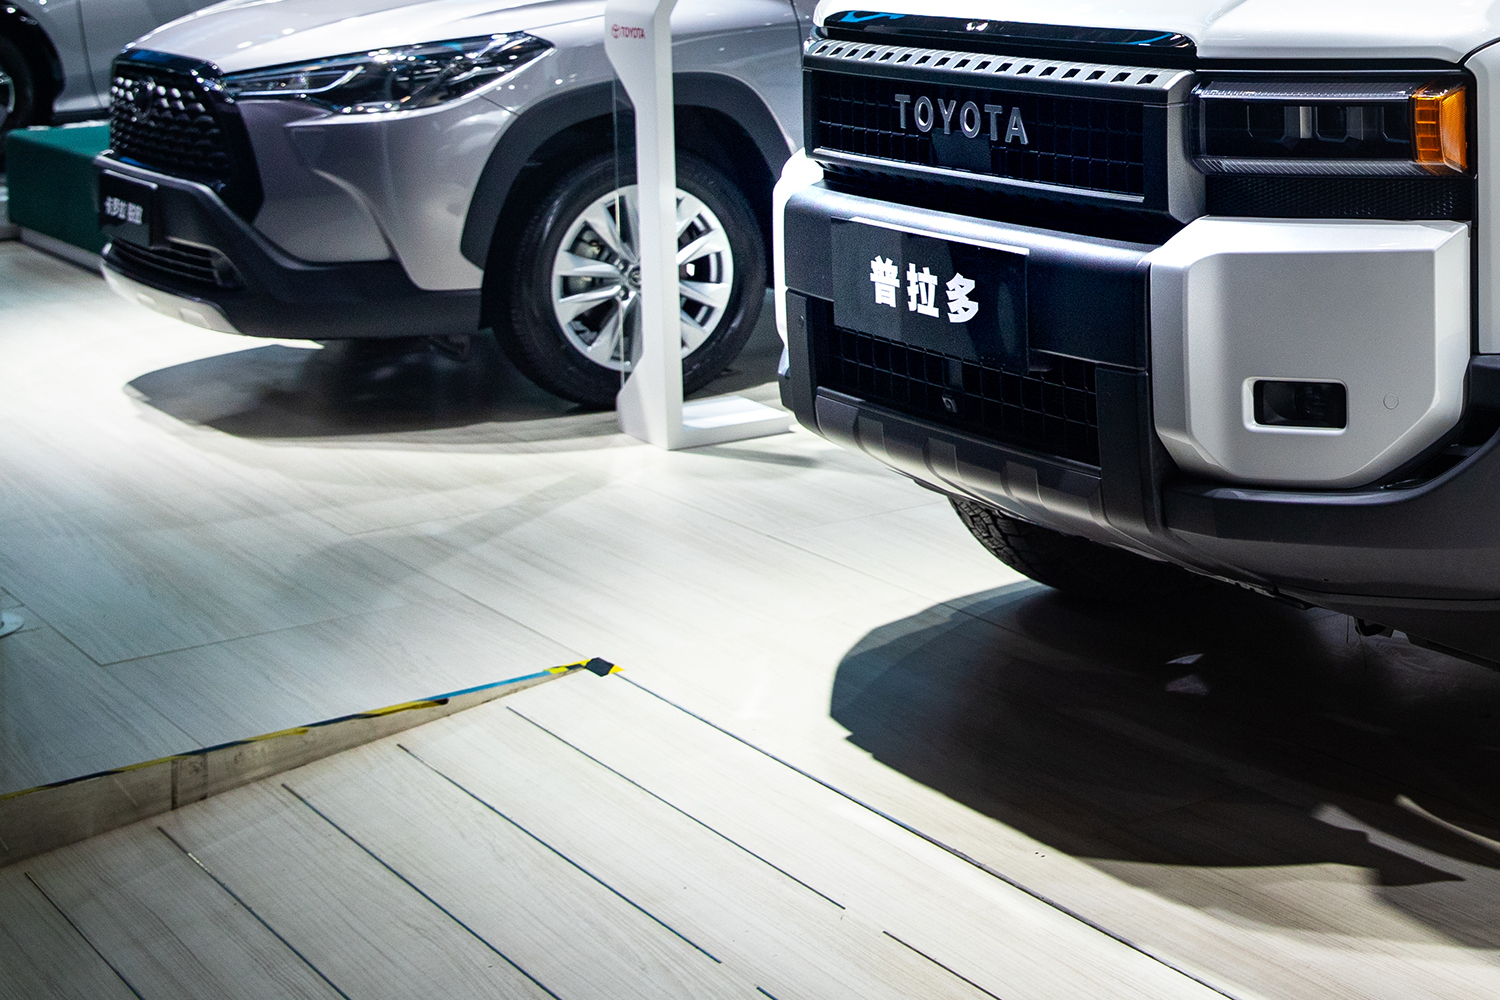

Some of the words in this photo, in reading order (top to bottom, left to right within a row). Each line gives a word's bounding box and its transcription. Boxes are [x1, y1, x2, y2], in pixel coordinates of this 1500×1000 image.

[620, 26, 646, 40] TOYOTA
[894, 93, 1029, 146] TOYOTA
[869, 255, 980, 325] 普拉多
